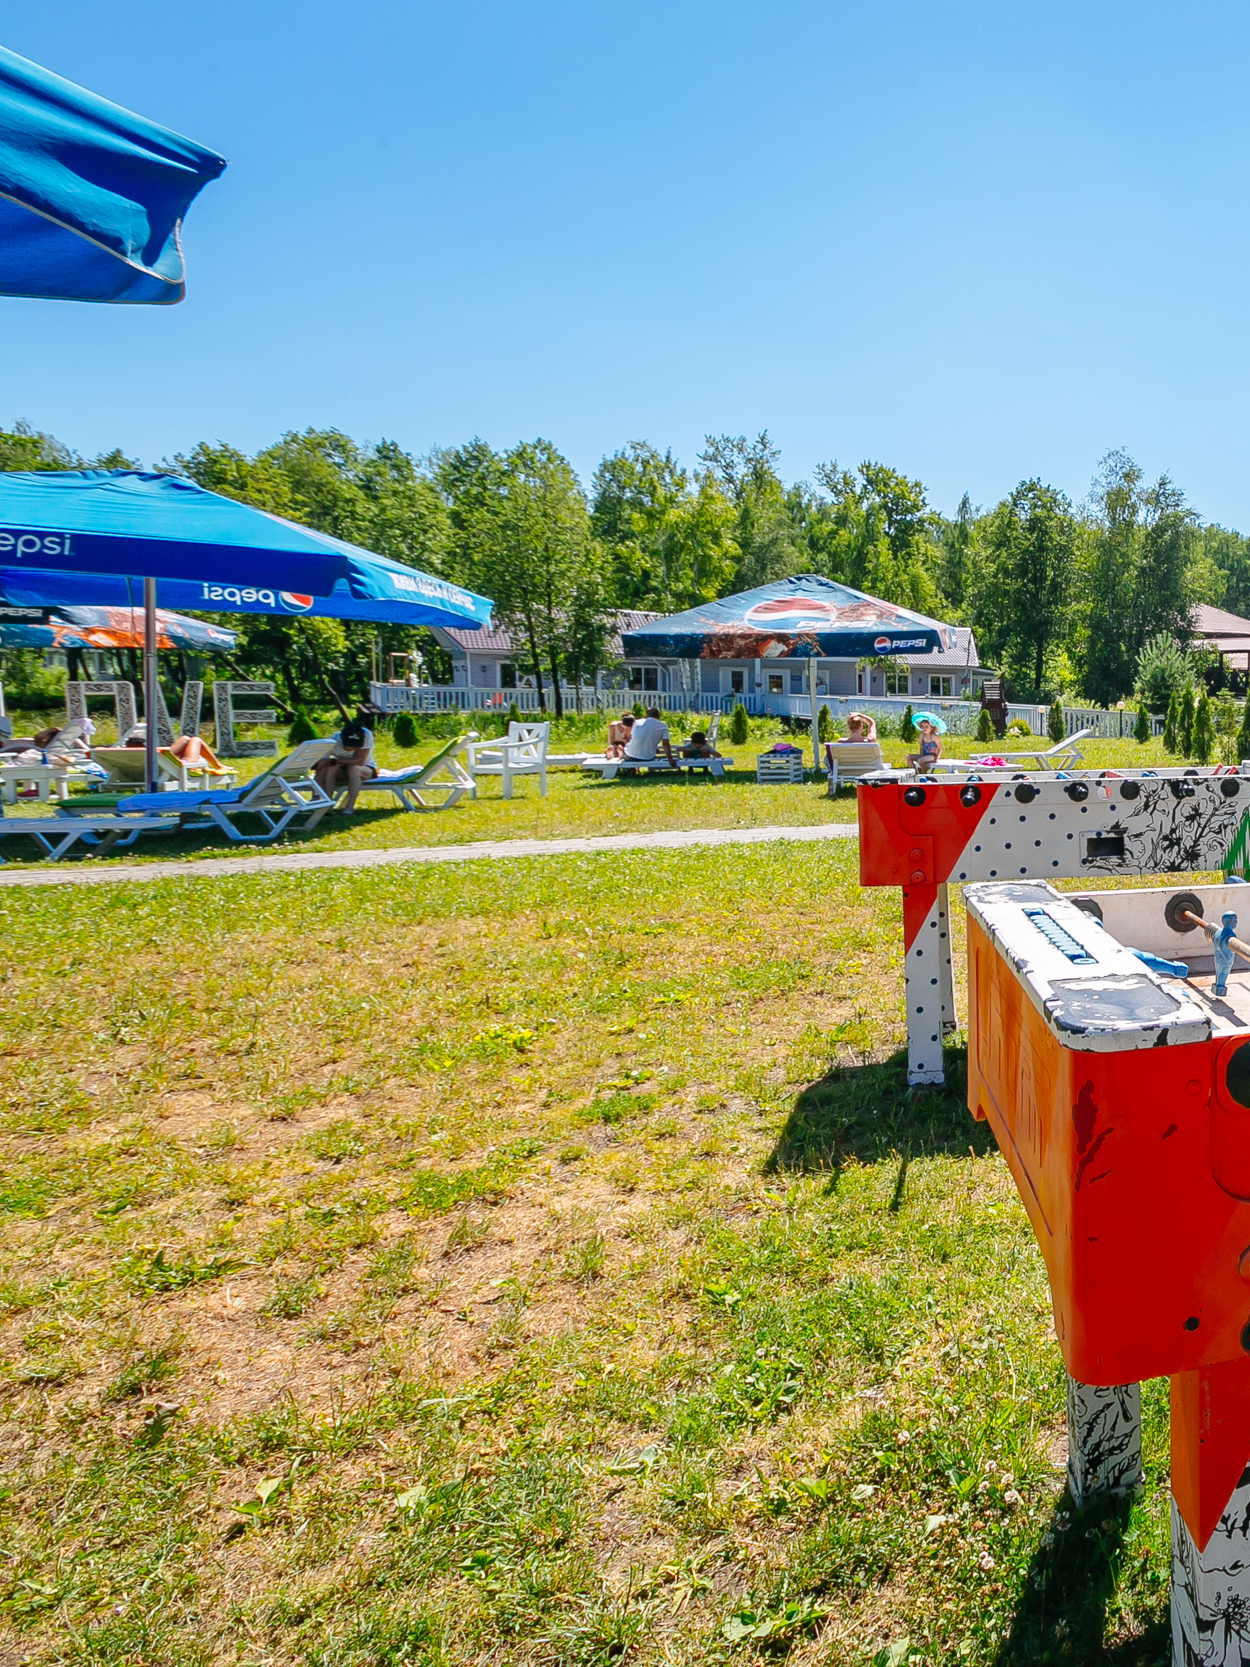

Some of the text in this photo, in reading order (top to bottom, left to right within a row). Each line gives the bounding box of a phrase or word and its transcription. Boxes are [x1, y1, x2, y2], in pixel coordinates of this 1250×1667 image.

[0, 533, 71, 558] epsi
[796, 620, 875, 628] PEPSI
[891, 638, 928, 649] PEPSI
[0, 680, 278, 758] OVE
